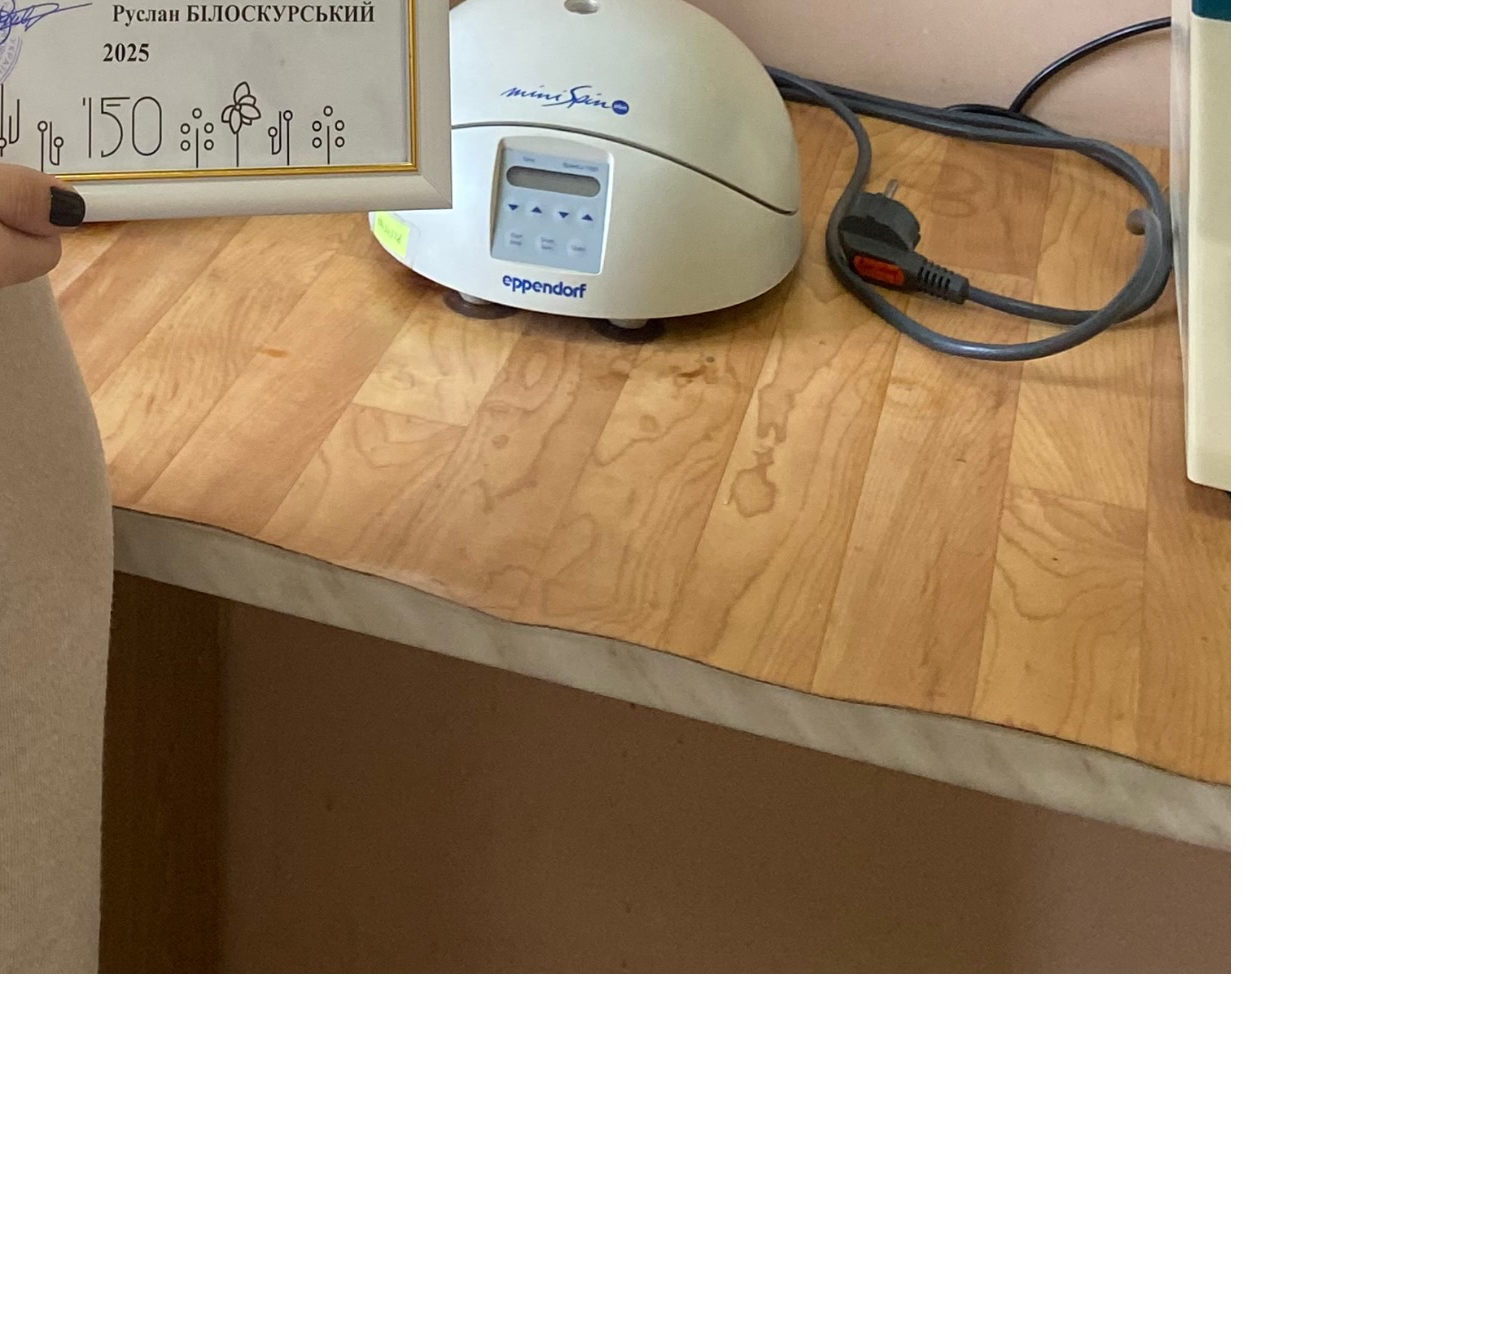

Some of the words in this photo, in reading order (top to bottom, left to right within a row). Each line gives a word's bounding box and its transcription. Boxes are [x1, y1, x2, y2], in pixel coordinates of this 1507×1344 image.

[113, 4, 180, 27] Руслан
[186, 1, 375, 23] БІЛОСКУРСЬКИЙ
[102, 43, 150, 63] 2025
[502, 275, 587, 298] eppendorf
